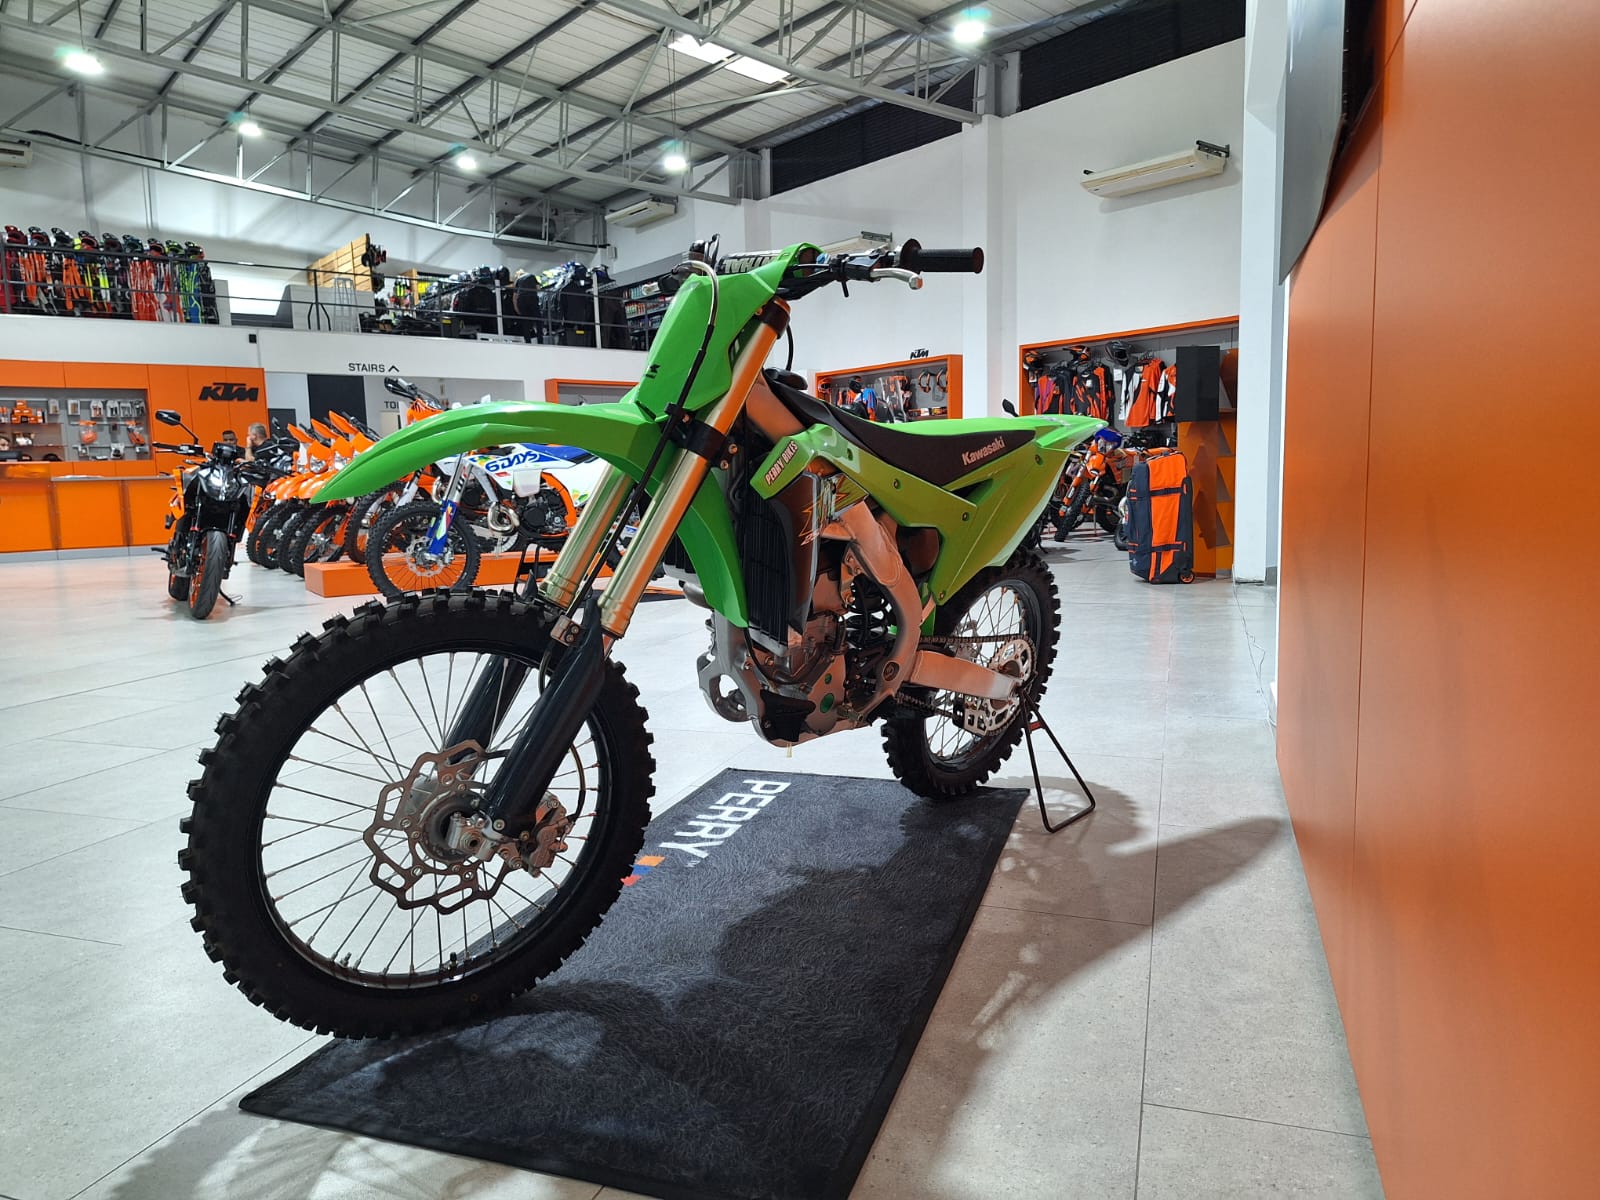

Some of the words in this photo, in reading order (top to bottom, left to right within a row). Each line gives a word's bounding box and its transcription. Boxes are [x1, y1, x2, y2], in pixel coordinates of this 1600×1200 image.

[909, 347, 929, 360] KTM
[348, 362, 386, 373] STAIRS
[198, 382, 259, 402] KTM
[384, 400, 400, 410] TOI
[961, 435, 1006, 466] Kawasaki
[485, 450, 539, 473] 6DAYS
[764, 457, 785, 486] PERRY
[781, 440, 798, 464] BIKES
[658, 779, 792, 859] PERRY
